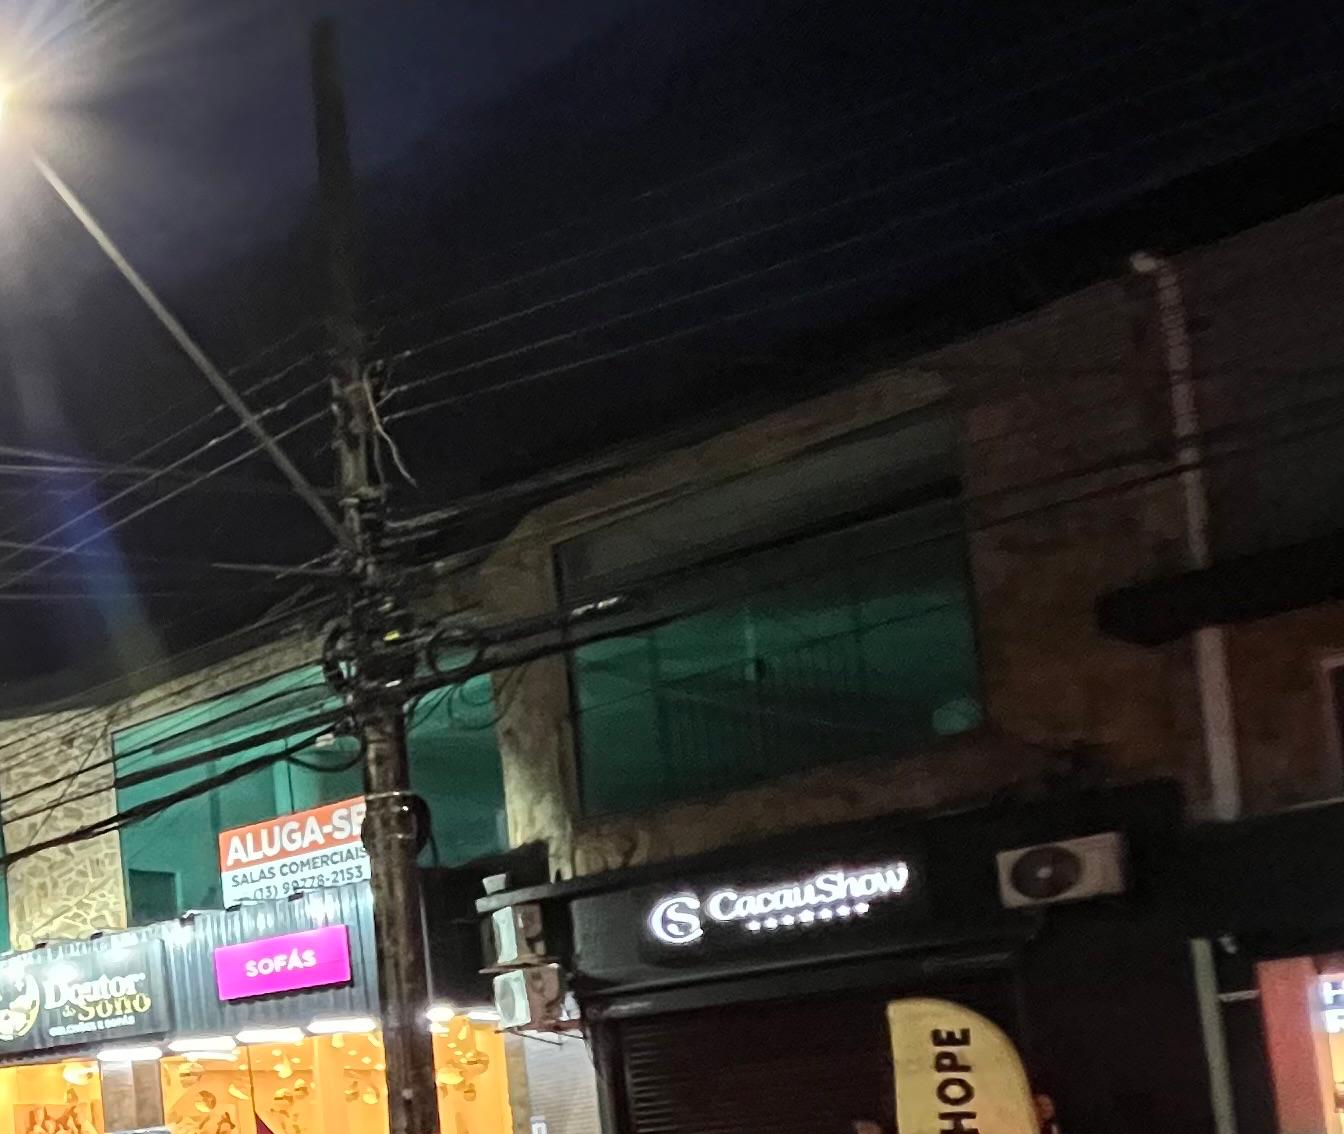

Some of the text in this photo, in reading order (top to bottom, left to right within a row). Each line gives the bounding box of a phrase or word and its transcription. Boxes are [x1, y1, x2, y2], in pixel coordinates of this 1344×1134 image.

[232, 847, 369, 887] SALAS COMERCIAIS
[245, 947, 317, 977] SOFÁS
[78, 993, 151, 1021] Sono
